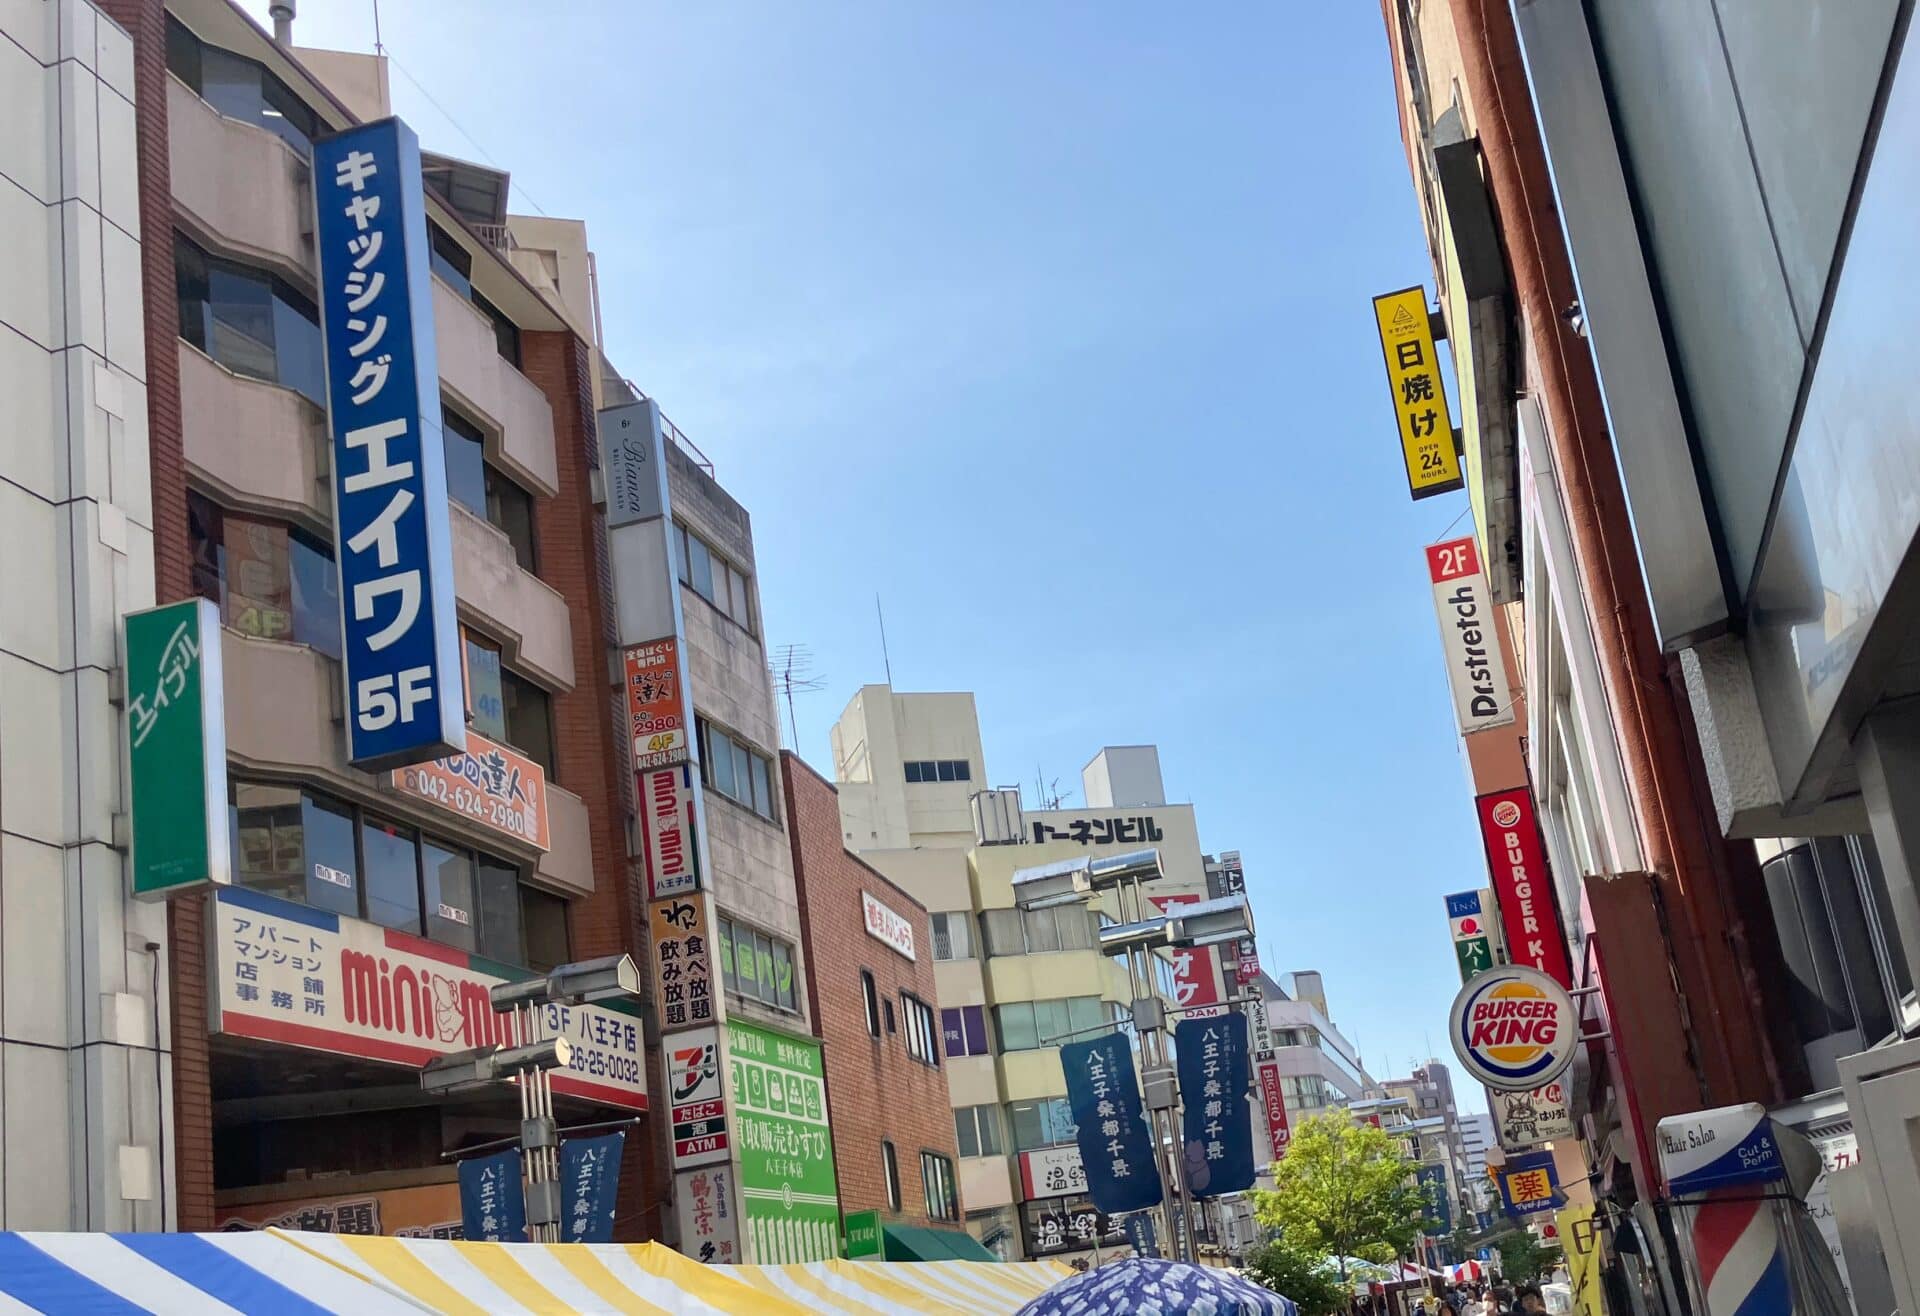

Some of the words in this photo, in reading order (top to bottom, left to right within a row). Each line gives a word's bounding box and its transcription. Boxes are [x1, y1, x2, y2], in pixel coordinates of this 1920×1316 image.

[335, 150, 392, 406] キャッシング
[1396, 339, 1437, 438] 日焼け
[1418, 443, 1439, 453] OPEN
[1420, 450, 1443, 471] 24
[622, 438, 647, 514] Bianca
[1421, 468, 1448, 480] HOURS
[344, 418, 422, 652] エイワ
[1438, 545, 1467, 576] 2F
[638, 656, 666, 668] 専門店
[1448, 586, 1499, 717] Dr.stretch
[129, 632, 202, 733] エイブル
[632, 671, 673, 685] ほぐしの
[358, 665, 432, 731] 5F
[636, 684, 669, 704] 達人
[648, 733, 674, 751] 4F
[637, 748, 687, 769] 042-624-2980
[418, 769, 524, 835] 042-624-2980
[653, 771, 678, 817] mini
[1033, 816, 1164, 846] トーネンビル
[659, 830, 685, 876] mini
[656, 875, 693, 890] 八王子店
[1503, 832, 1540, 934] BURGER
[661, 900, 698, 930] わん
[233, 917, 323, 953] アパート
[234, 940, 322, 974] マンション
[1243, 962, 1260, 974] 4F
[340, 948, 434, 1040] mini
[660, 941, 686, 1025] 飲み放題
[684, 936, 712, 1021] 食べ放題
[235, 983, 325, 1018] 事務所
[1185, 1008, 1218, 1018] DAM
[1473, 1000, 1558, 1021] BURGER
[547, 1004, 571, 1032] 3F
[580, 1011, 637, 1054] 八王子店
[1470, 1019, 1557, 1049] KING
[569, 1043, 641, 1085] 26-25-0032
[777, 1041, 811, 1070] 無料査定
[1201, 1027, 1225, 1161] 八王子桑都千景
[1263, 1069, 1275, 1091] BIG
[680, 1104, 717, 1121] たばこ
[1087, 1049, 1131, 1178] 八王子桑都千景
[1267, 1091, 1281, 1122] ECHO
[692, 1122, 708, 1136] 酒
[1666, 1135, 1688, 1154] Hair
[1688, 1123, 1715, 1149] Salon
[687, 1138, 717, 1154] ATM
[1738, 1143, 1759, 1160] Cut
[1761, 1137, 1770, 1149] &
[1743, 1148, 1773, 1168] Perm
[766, 1158, 804, 1179] 八王子本店
[573, 1148, 597, 1243] 八王子桑都
[1514, 1172, 1544, 1202] 薬
